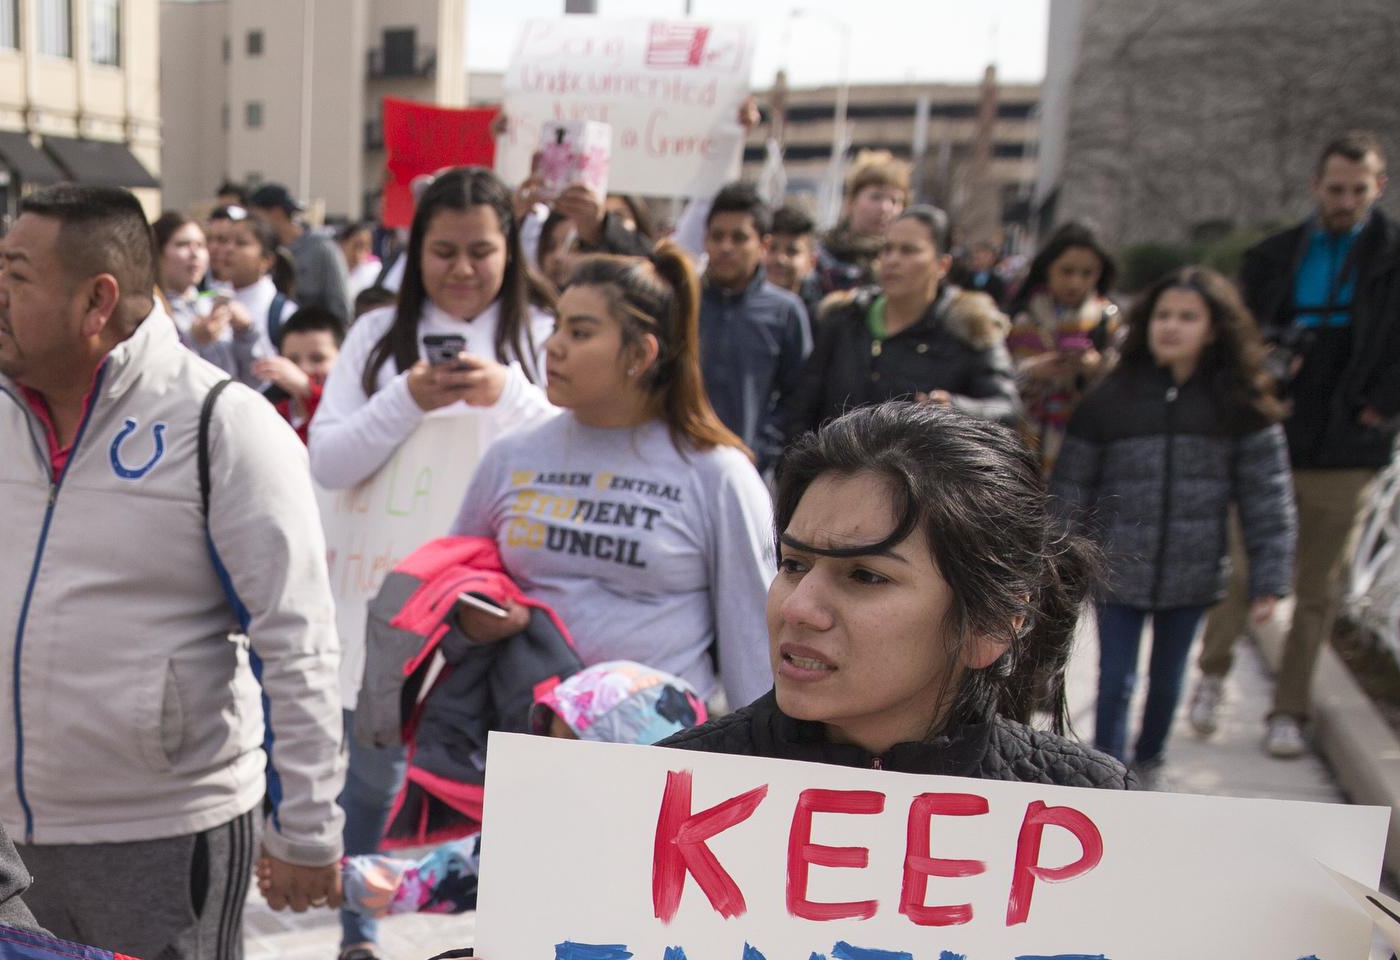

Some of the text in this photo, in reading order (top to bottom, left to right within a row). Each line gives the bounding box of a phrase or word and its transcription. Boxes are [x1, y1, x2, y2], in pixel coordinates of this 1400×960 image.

[511, 489, 662, 531] STUDENT
[506, 516, 647, 569] COUNCIL
[651, 769, 1104, 926] KEEP
